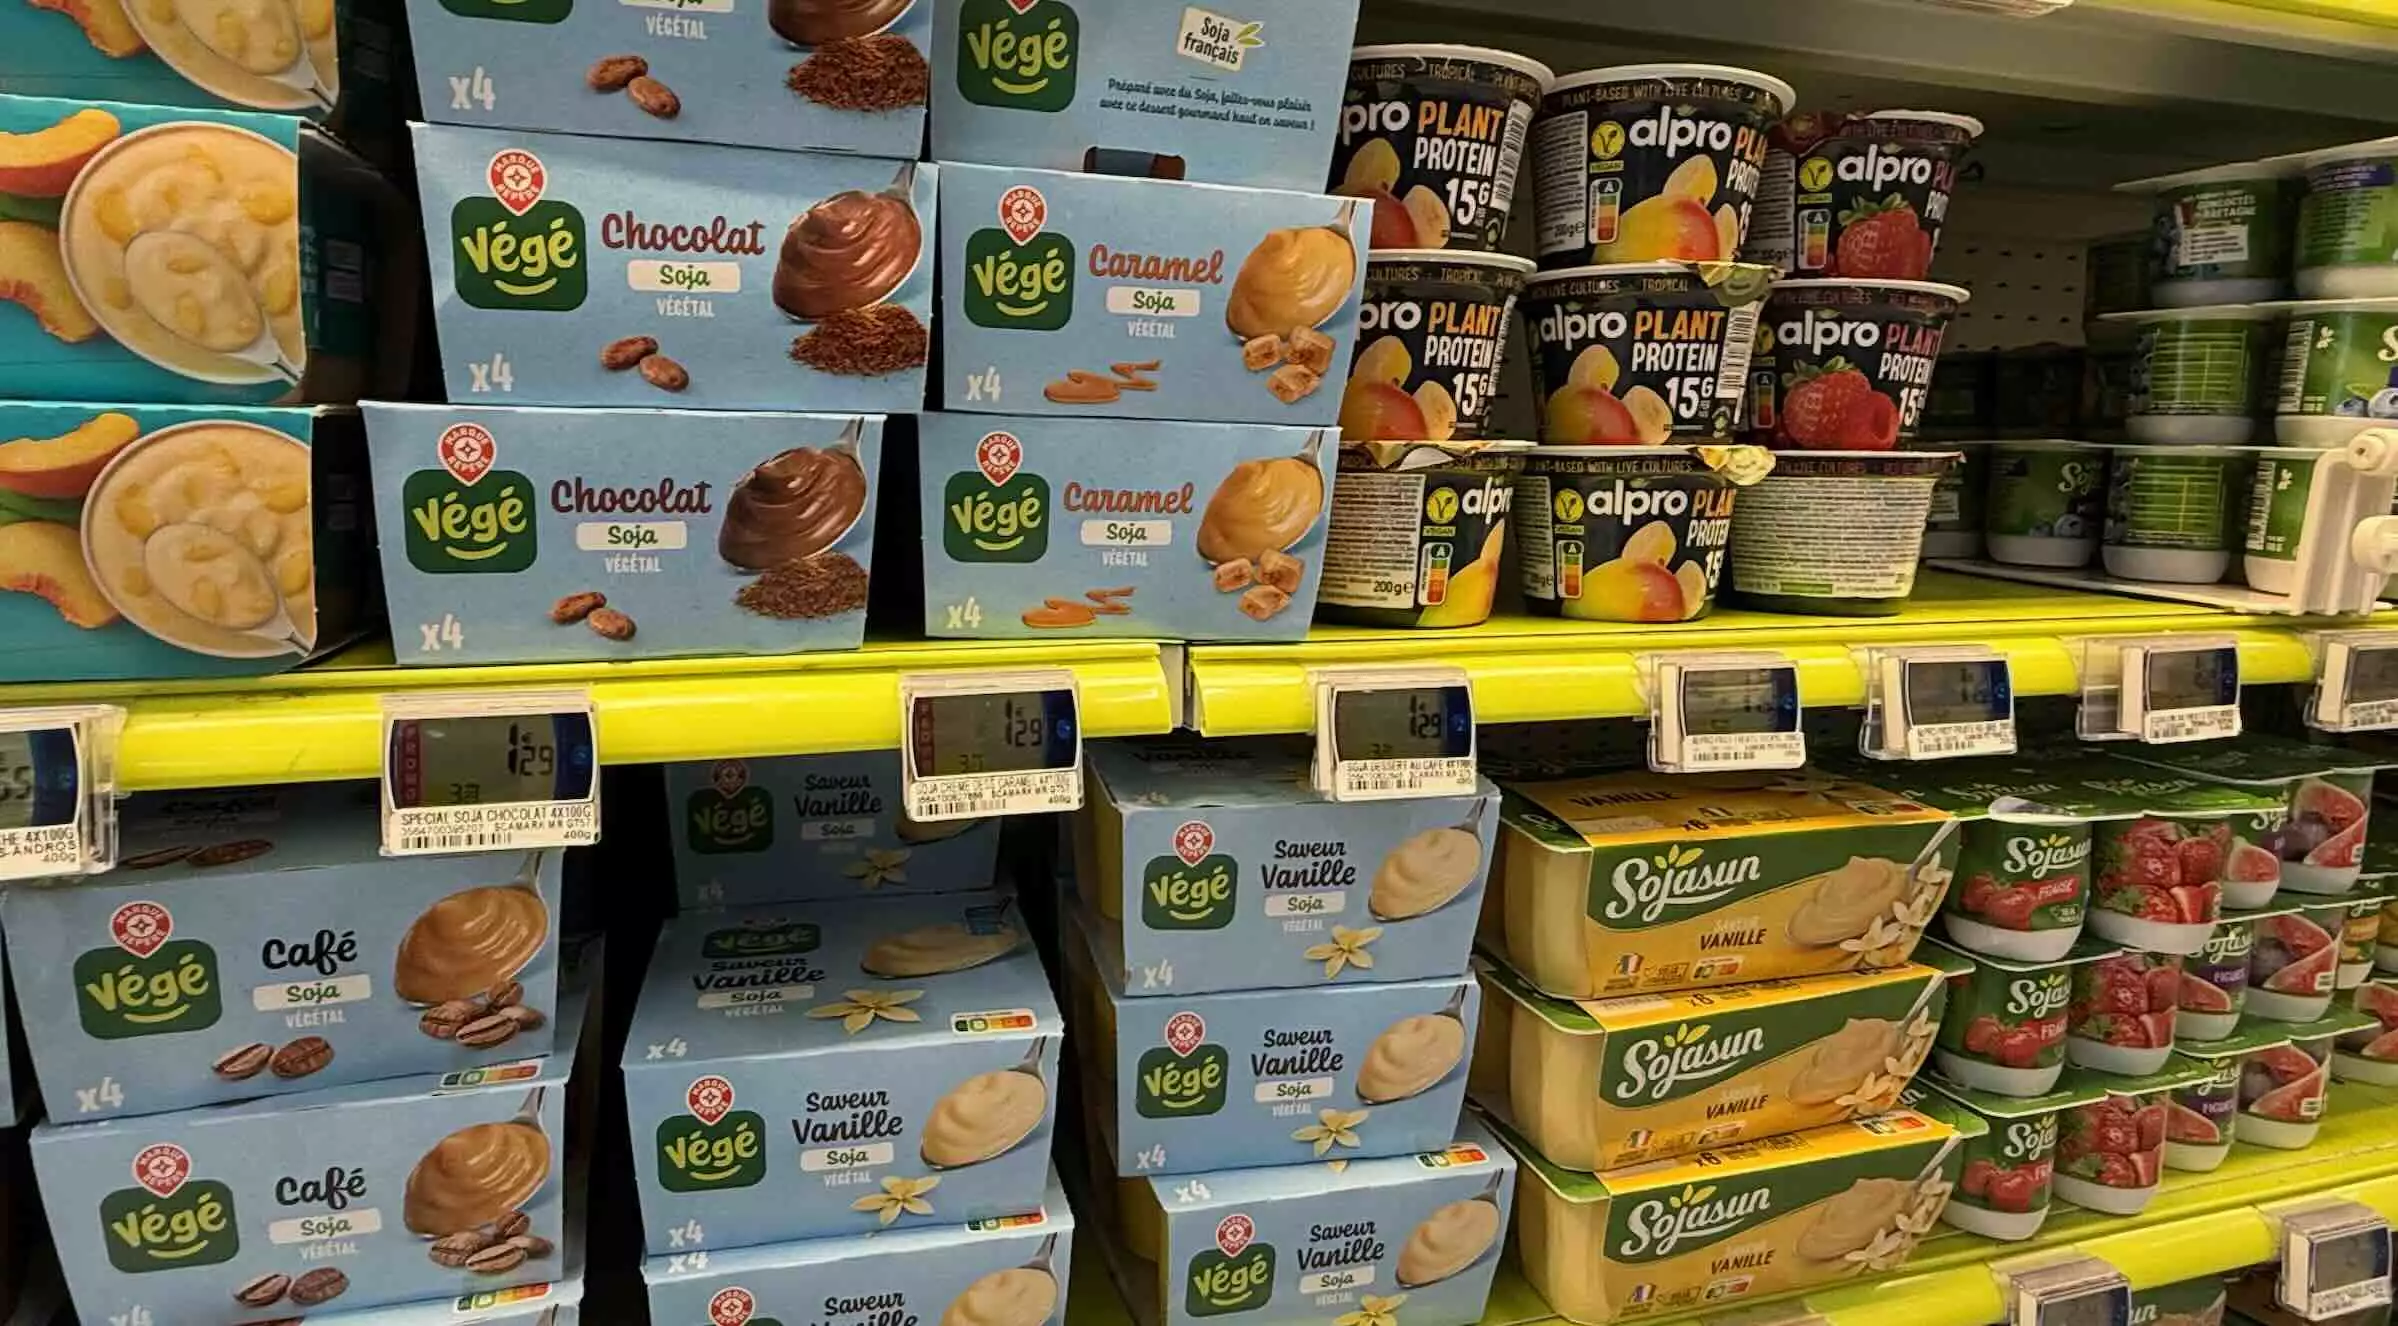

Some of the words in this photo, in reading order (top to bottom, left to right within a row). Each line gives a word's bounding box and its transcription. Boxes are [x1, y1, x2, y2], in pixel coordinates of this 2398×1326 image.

[646, 14, 708, 40] VÉGÉTAL
[1201, 16, 1231, 44] Soja
[966, 18, 1072, 78] Végé
[1184, 32, 1240, 65] français
[449, 65, 496, 111] x4
[1177, 85, 1193, 99] du
[1342, 100, 1411, 146] pro
[1418, 101, 1504, 142] PLANT
[1628, 105, 1733, 159] alpro
[1413, 137, 1498, 177] PROTEIN
[1837, 143, 1932, 192] alpro
[1445, 177, 1491, 226] 15G
[461, 217, 578, 279] Végé
[601, 210, 767, 256] Chocolat
[658, 264, 711, 291] Soja
[973, 248, 1067, 301] Végé
[1088, 244, 1224, 285] Caramel
[656, 297, 716, 319] VÉGÉTAL
[1132, 291, 1176, 313] Soja
[1127, 319, 1177, 340] VÉGÉTAL
[1359, 301, 1422, 341] pro
[1427, 302, 1500, 337] PLANT
[1540, 303, 1628, 351] alpro
[1634, 310, 1725, 341] PLANT
[1777, 309, 1880, 356] alpro
[1424, 335, 1495, 369] PROTEIN
[1631, 341, 1719, 374] PROTEIN
[468, 351, 514, 393] x4
[966, 366, 1002, 402] x4
[1665, 376, 1714, 420] 15G
[551, 477, 713, 515] Chocolat
[1063, 481, 1194, 515] Caramel
[1461, 476, 1514, 525] alpr
[1586, 478, 1689, 526] alpro
[412, 485, 527, 543] Végé
[951, 487, 1042, 537] Végé
[607, 524, 659, 548] Soja
[1105, 522, 1147, 542] Soja
[604, 553, 663, 574] VÉGÉTAL
[1102, 549, 1150, 568] VÉGÉTAL
[945, 597, 982, 630] x4
[420, 612, 465, 652] x4
[803, 773, 871, 794] Saveur
[401, 812, 449, 827] SPECIAL
[453, 810, 483, 825] SOJA
[486, 808, 547, 822] CHOCOLAT
[549, 804, 592, 819] 4X100G
[692, 798, 768, 835] Végé
[793, 790, 883, 820] Vanille
[494, 821, 543, 832] SCAMARK
[820, 822, 856, 838] Soja
[1273, 838, 1348, 860] Saveur
[1150, 866, 1231, 908] Végé
[1260, 859, 1356, 890] Vanille
[1604, 855, 1762, 922] Sojasun
[1287, 895, 1324, 913] Soja
[261, 928, 358, 977] Café
[1700, 928, 1768, 951] VANILLE
[691, 966, 829, 992] Vanille
[711, 957, 810, 971] Saveur
[1143, 959, 1174, 989] x4
[85, 953, 209, 1011] Végé
[286, 983, 340, 1007] Soja
[730, 988, 783, 1003] Soja
[285, 1007, 346, 1029] VÉGÉTAL
[646, 1037, 688, 1062] x4
[1262, 1027, 1335, 1049] Saveur
[1143, 1054, 1222, 1098] Végé
[1250, 1048, 1344, 1077] Vanille
[1616, 1026, 1765, 1099] Sojasun
[76, 1077, 124, 1114] x4
[806, 1089, 890, 1114] Saveur
[1276, 1080, 1313, 1098] Soja
[1705, 1094, 1769, 1120] VANILLE
[791, 1109, 904, 1146] Vanille
[664, 1121, 759, 1169] Végé
[826, 1147, 869, 1167] Soja
[1137, 1143, 1167, 1171] x4
[275, 1166, 367, 1210] Café
[823, 1170, 873, 1188] VÉGÉTAL
[1177, 1179, 1212, 1204] x4
[112, 1192, 227, 1248] Végé
[300, 1215, 352, 1237] Soja
[668, 1219, 705, 1248] x4
[1308, 1219, 1377, 1243] Saveur
[1620, 1187, 1771, 1256] Sojasun
[298, 1241, 359, 1260] VÉGÉTAL
[667, 1250, 711, 1275] x4
[1296, 1238, 1385, 1273] Vanille
[1711, 1249, 1776, 1276] VANILLE
[1192, 1254, 1269, 1299] Végé
[1319, 1271, 1355, 1289] Soja
[823, 1290, 906, 1316] Saveur
